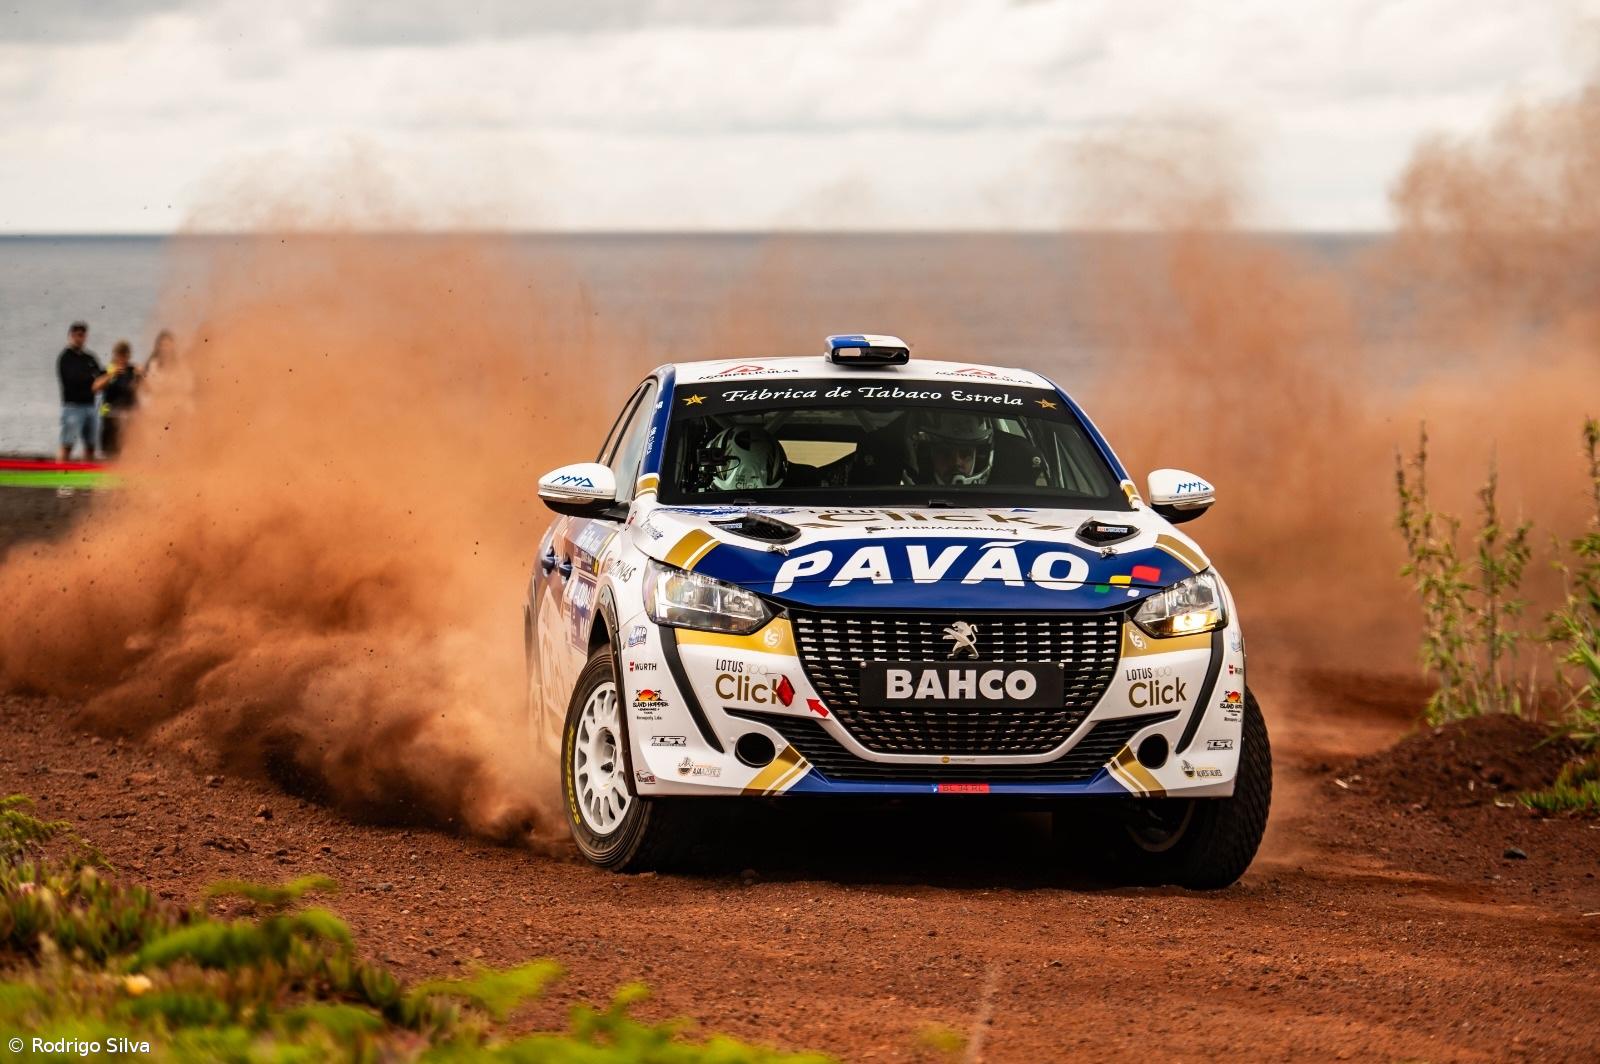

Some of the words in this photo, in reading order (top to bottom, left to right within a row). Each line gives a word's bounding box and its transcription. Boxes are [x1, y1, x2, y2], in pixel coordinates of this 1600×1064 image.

[722, 388, 817, 402] Fábrica
[825, 387, 852, 398] de
[858, 387, 942, 399] Tabaco
[951, 390, 1024, 405] Estrela
[818, 510, 1041, 524] Click
[772, 540, 1089, 595] PAVÃO
[715, 658, 744, 673] LOTUS
[1126, 667, 1153, 682] LOTUS
[886, 669, 1037, 700] BAHCO
[1128, 676, 1187, 708] Click
